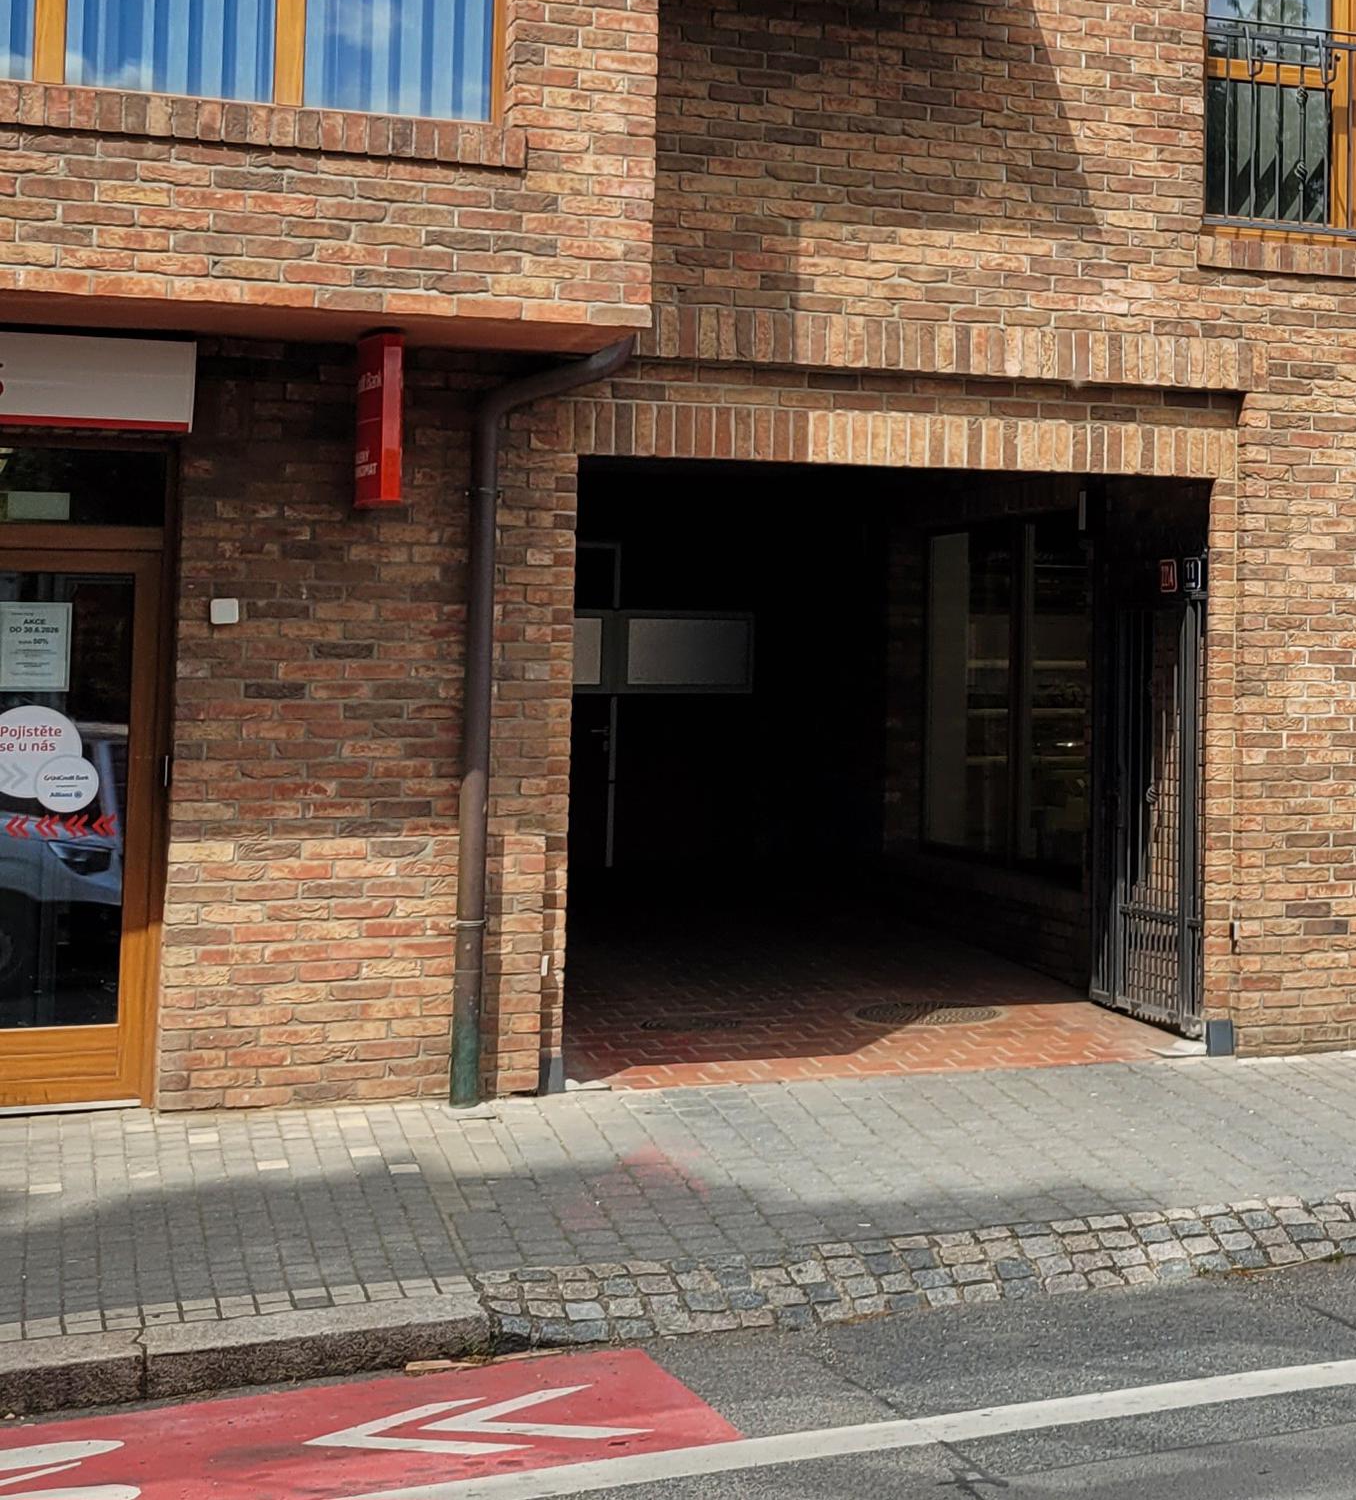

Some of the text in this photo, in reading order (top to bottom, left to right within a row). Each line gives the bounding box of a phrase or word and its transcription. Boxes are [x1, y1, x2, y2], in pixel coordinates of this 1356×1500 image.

[1186, 561, 1195, 580] 11
[0, 725, 62, 740] Pojistěte
[0, 740, 56, 752] se u nás
